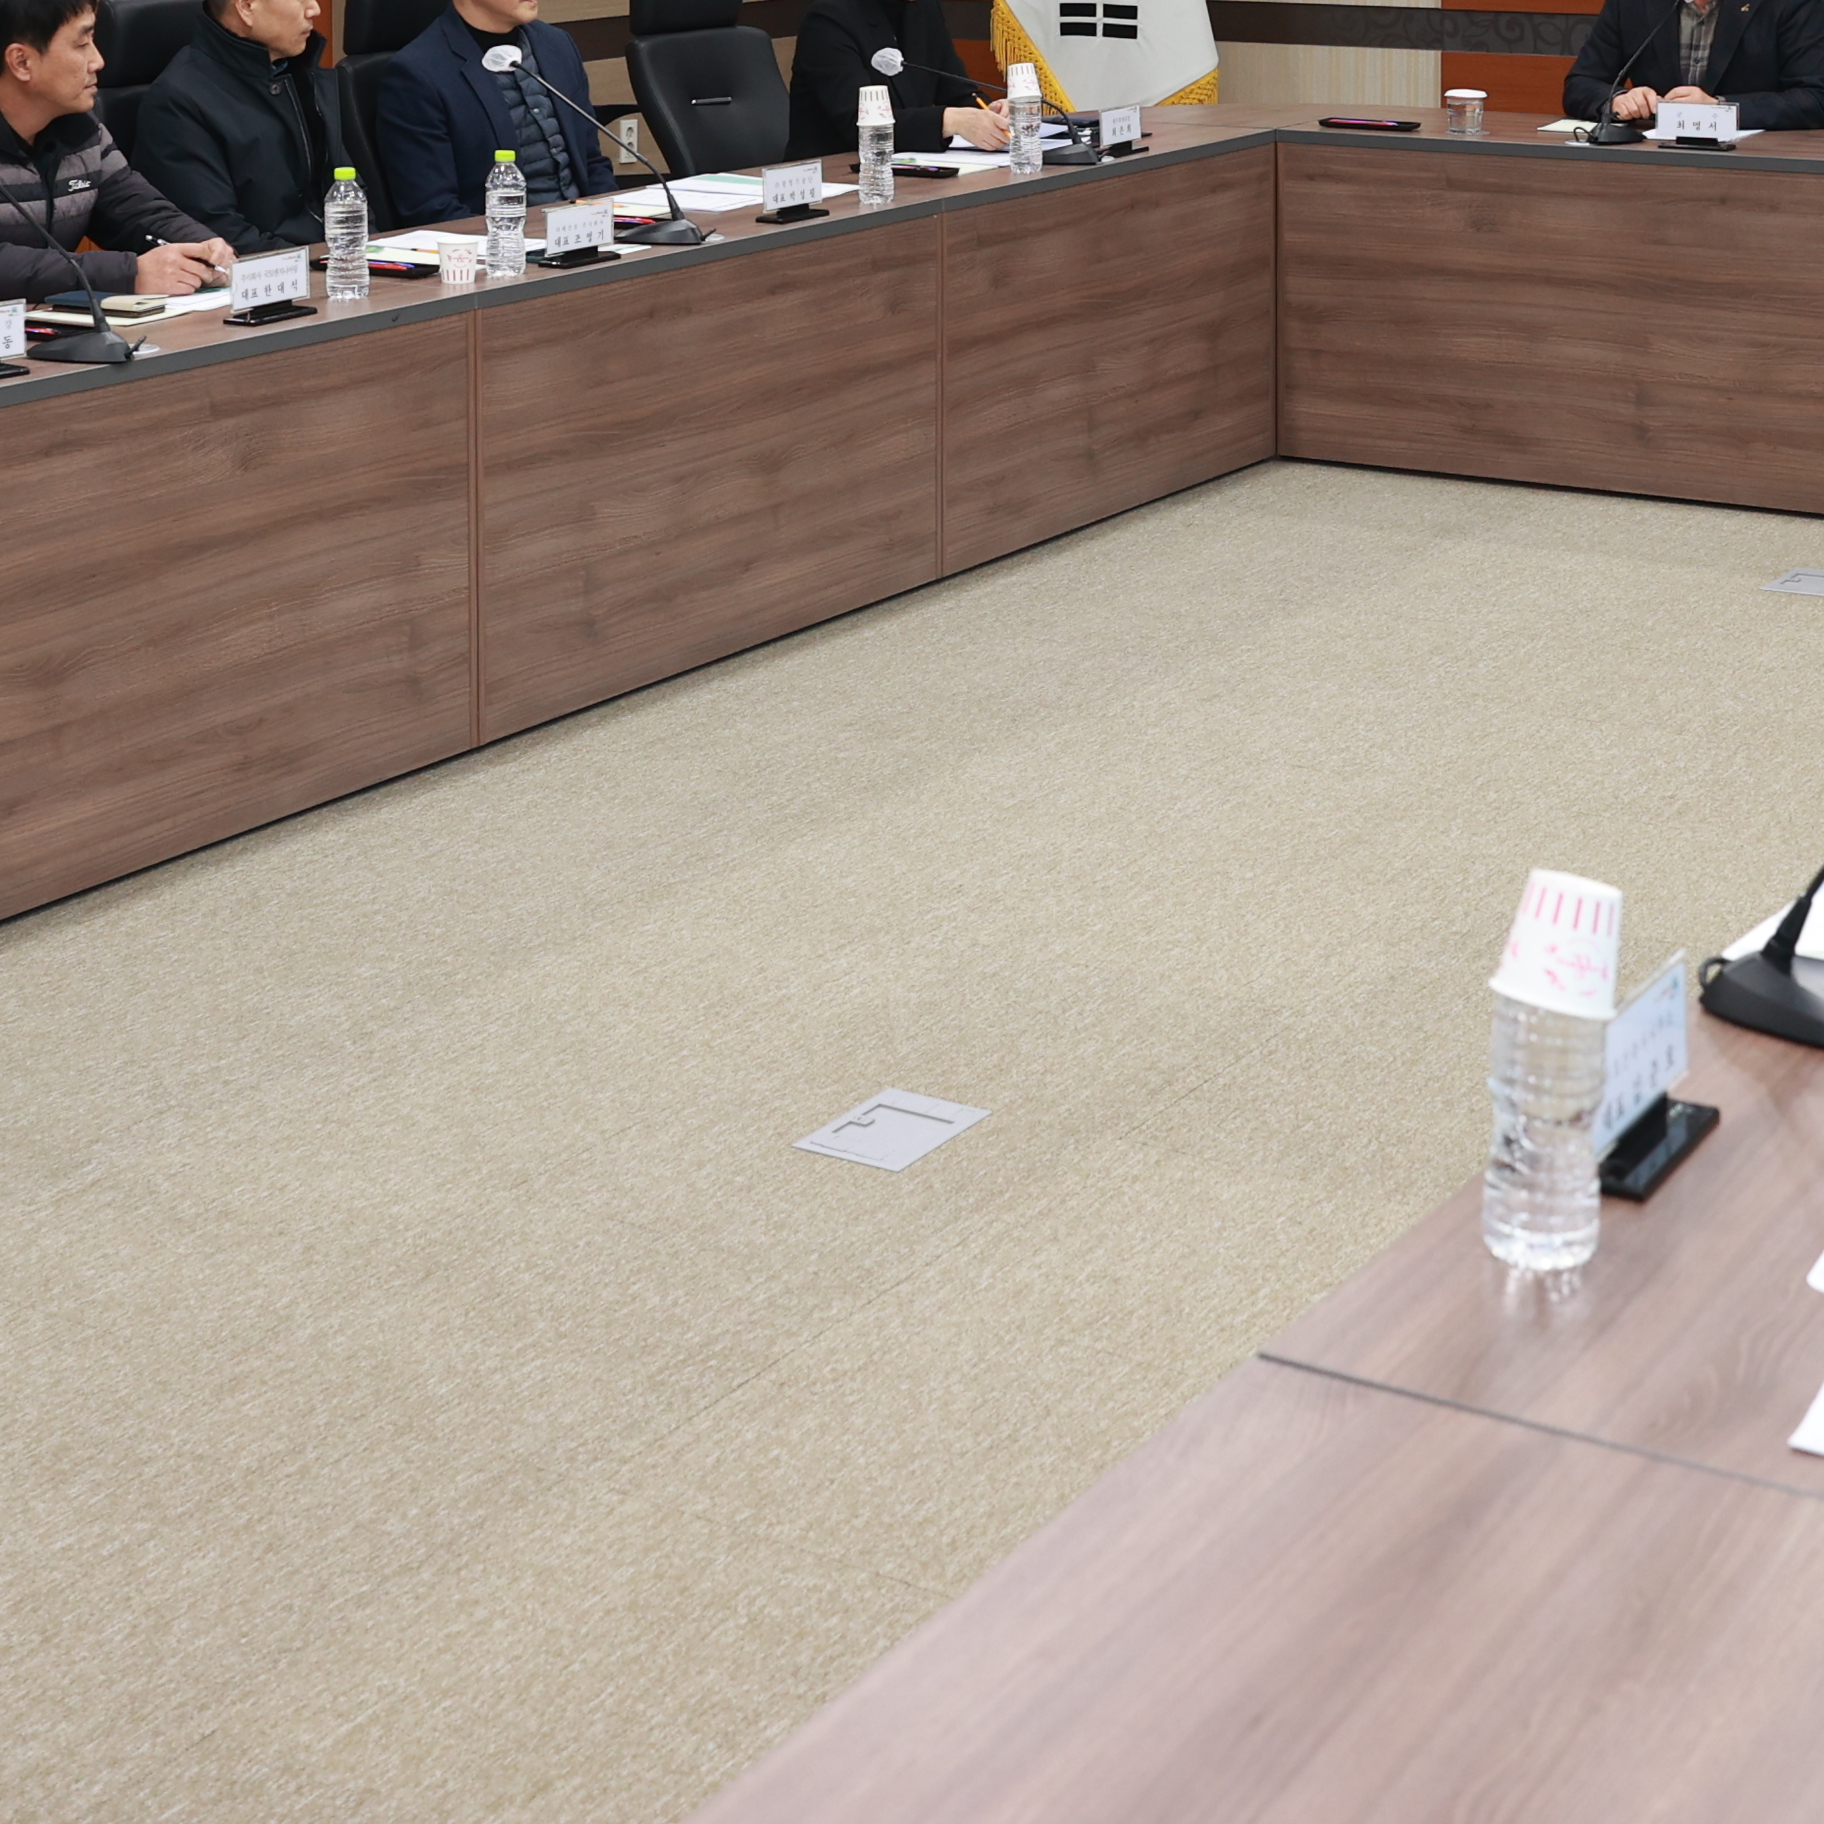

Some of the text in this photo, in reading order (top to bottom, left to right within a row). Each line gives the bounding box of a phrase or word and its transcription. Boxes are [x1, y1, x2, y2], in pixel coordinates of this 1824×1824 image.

[1676, 120, 1717, 132] 최명서
[554, 235, 570, 248] 대표
[241, 287, 259, 301] 대표
